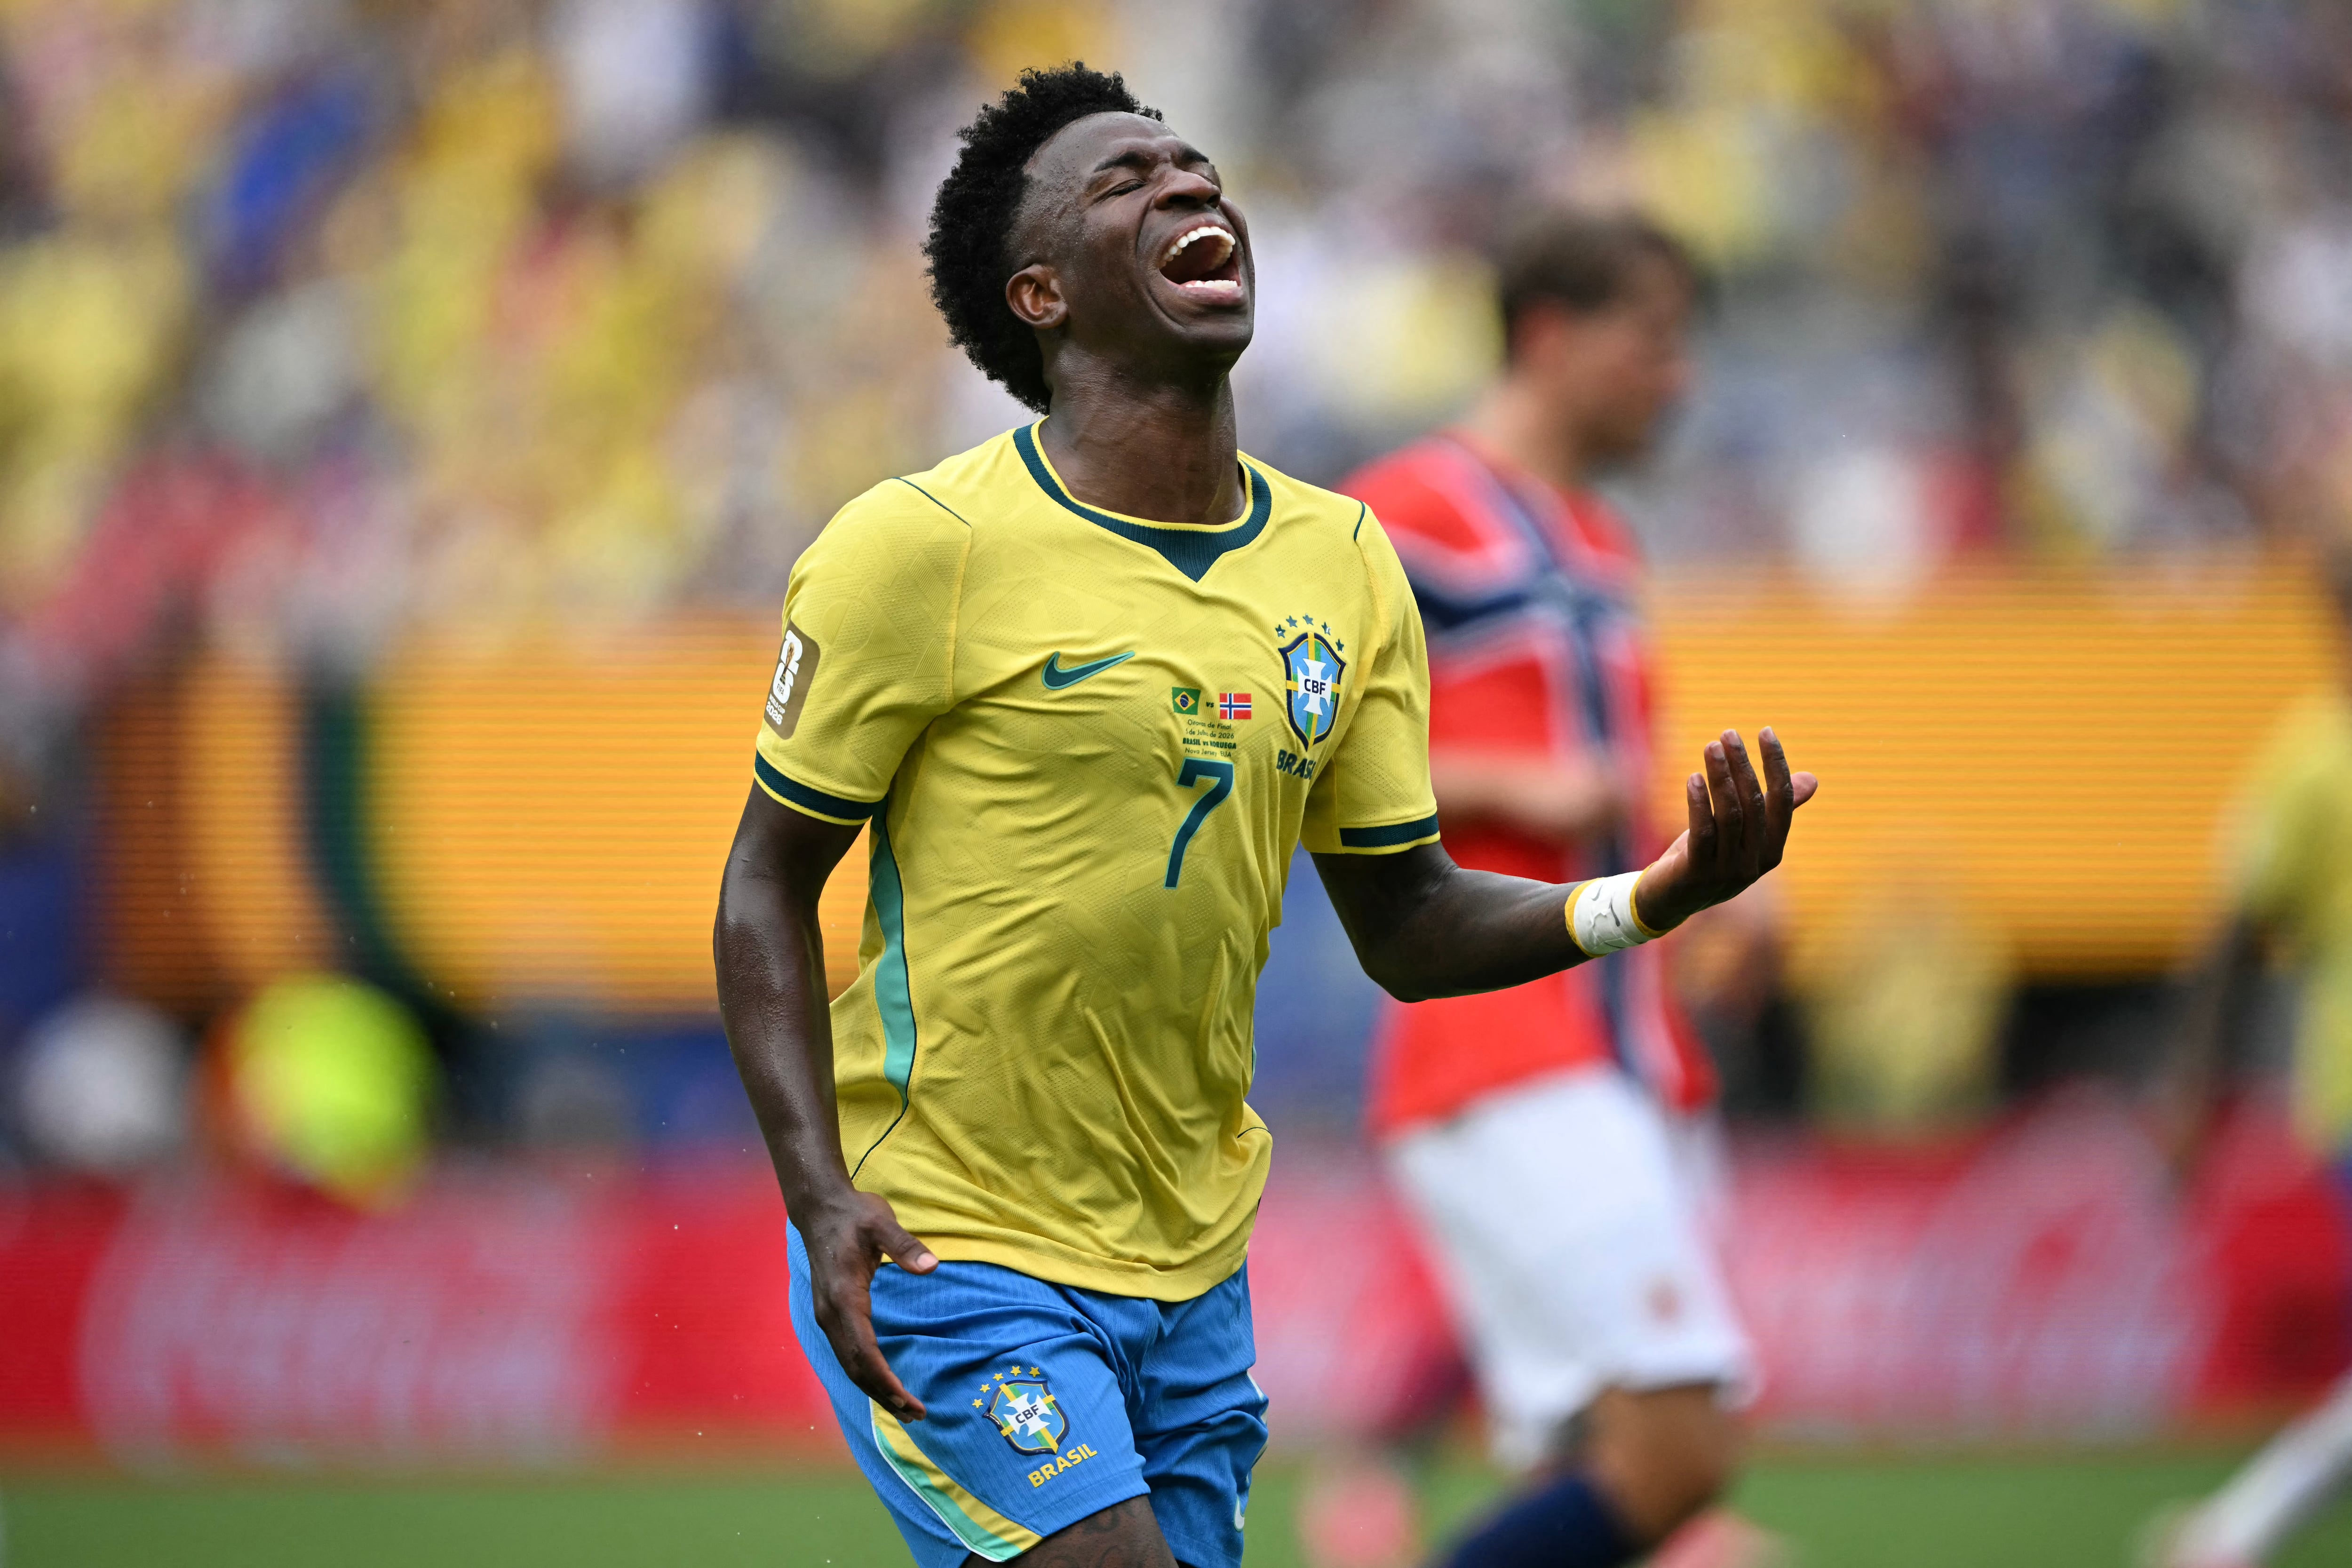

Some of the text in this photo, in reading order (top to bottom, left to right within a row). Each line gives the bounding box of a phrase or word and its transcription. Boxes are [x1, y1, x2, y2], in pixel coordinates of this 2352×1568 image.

[1304, 678, 1326, 695] CBF
[766, 701, 783, 724] 2026
[1210, 740, 1236, 749] NORUEGA
[1276, 749, 1317, 780] BRASI
[1163, 756, 1234, 890] 7
[1015, 1404, 1039, 1424] CBF
[1028, 1443, 1097, 1488] BRASIL
